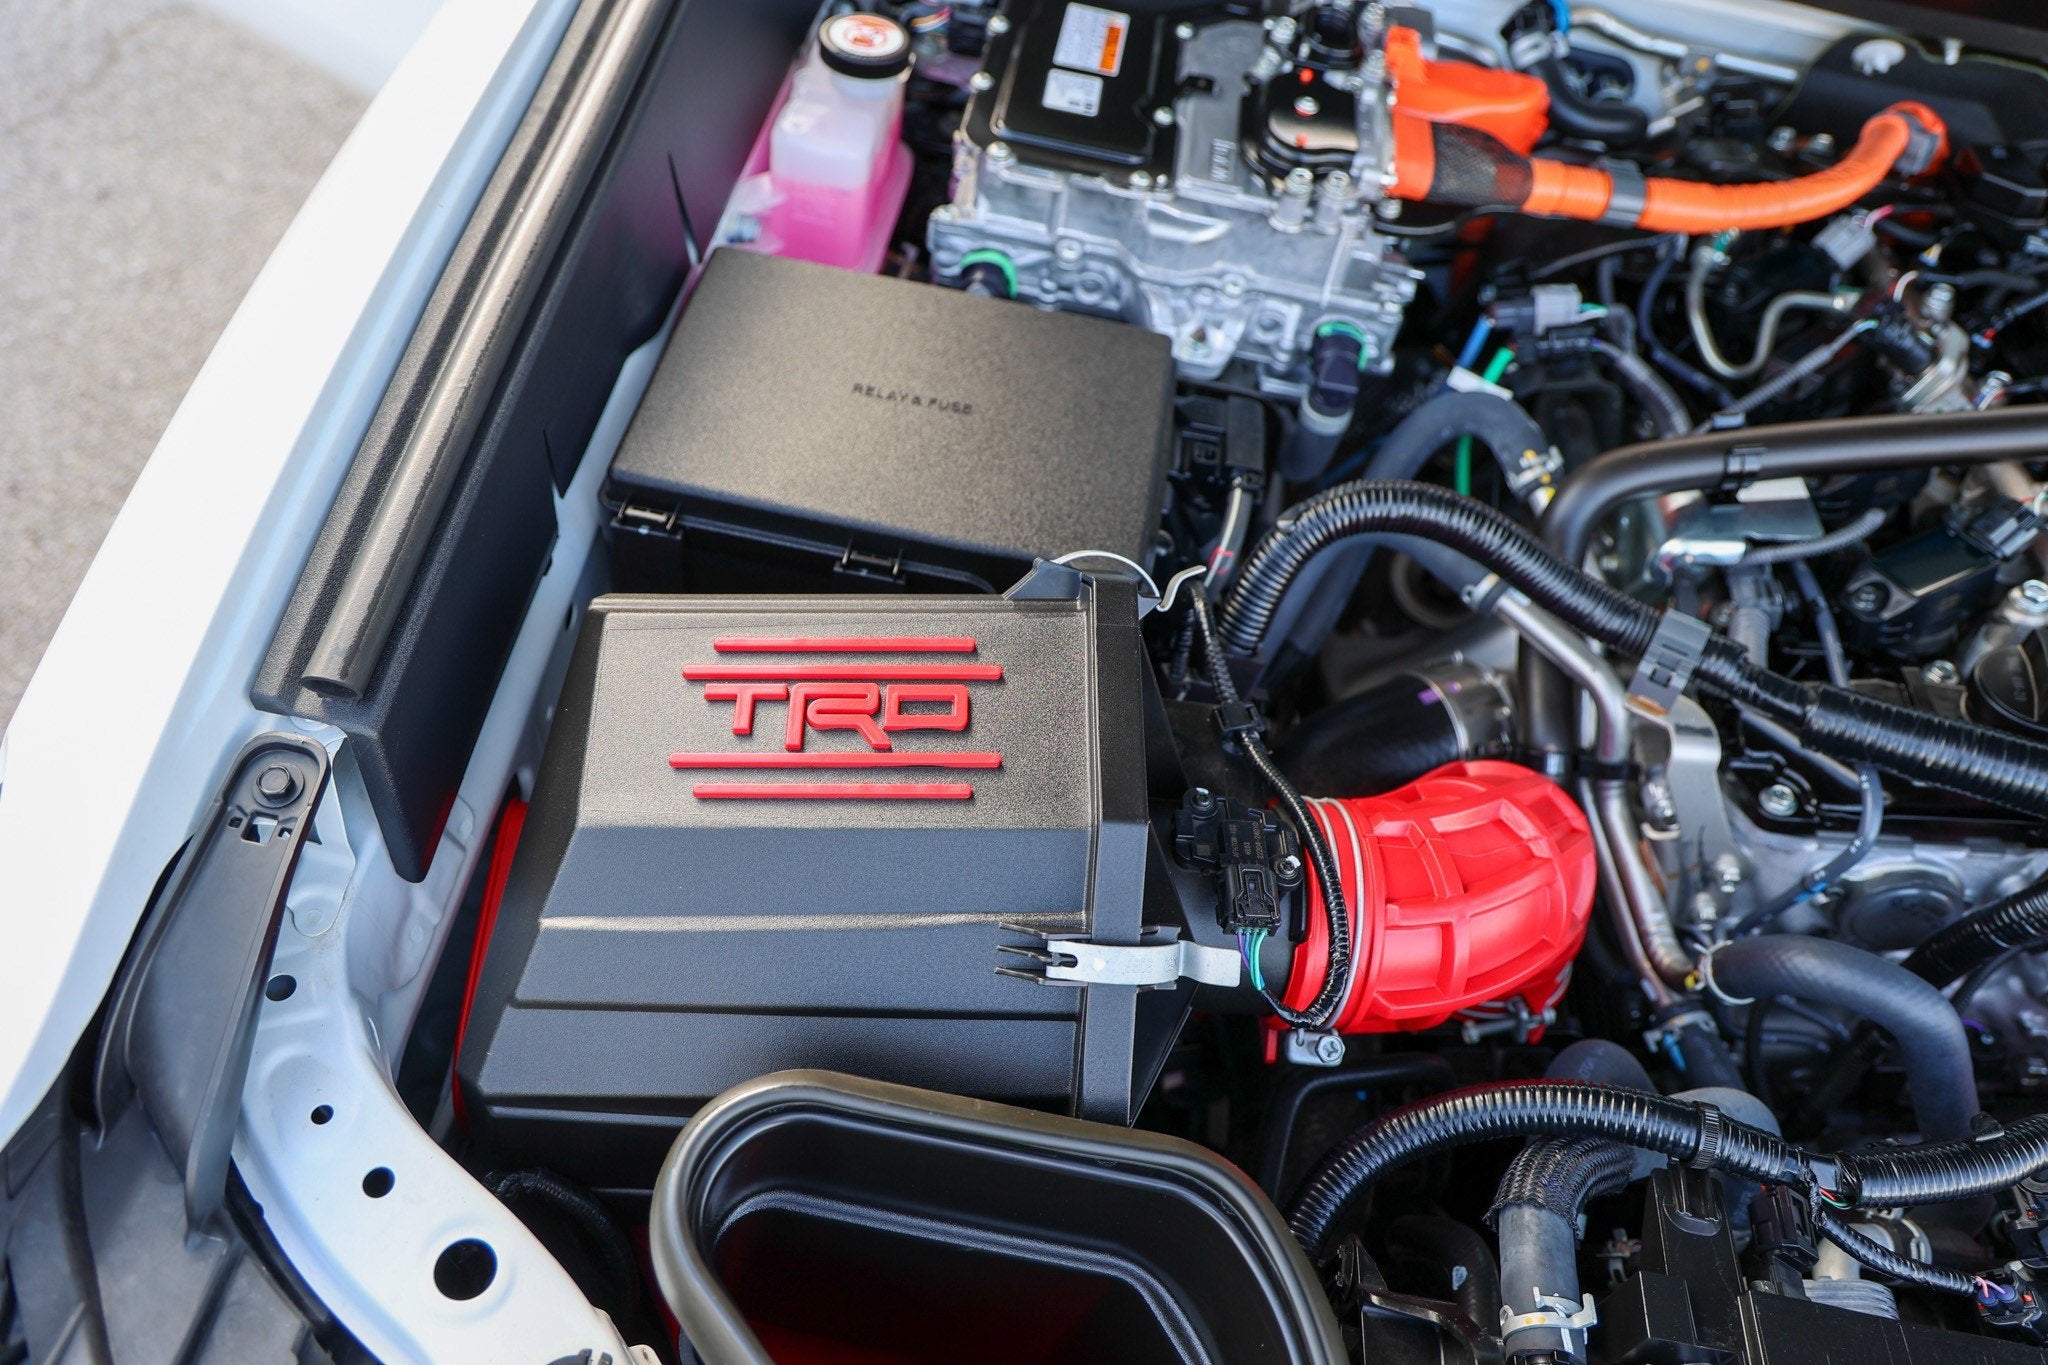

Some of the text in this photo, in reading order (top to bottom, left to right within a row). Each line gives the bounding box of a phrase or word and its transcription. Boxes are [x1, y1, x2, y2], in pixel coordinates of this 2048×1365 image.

[852, 382, 909, 401] RELAY
[928, 397, 973, 416] FUSE
[704, 682, 970, 751] TRD
